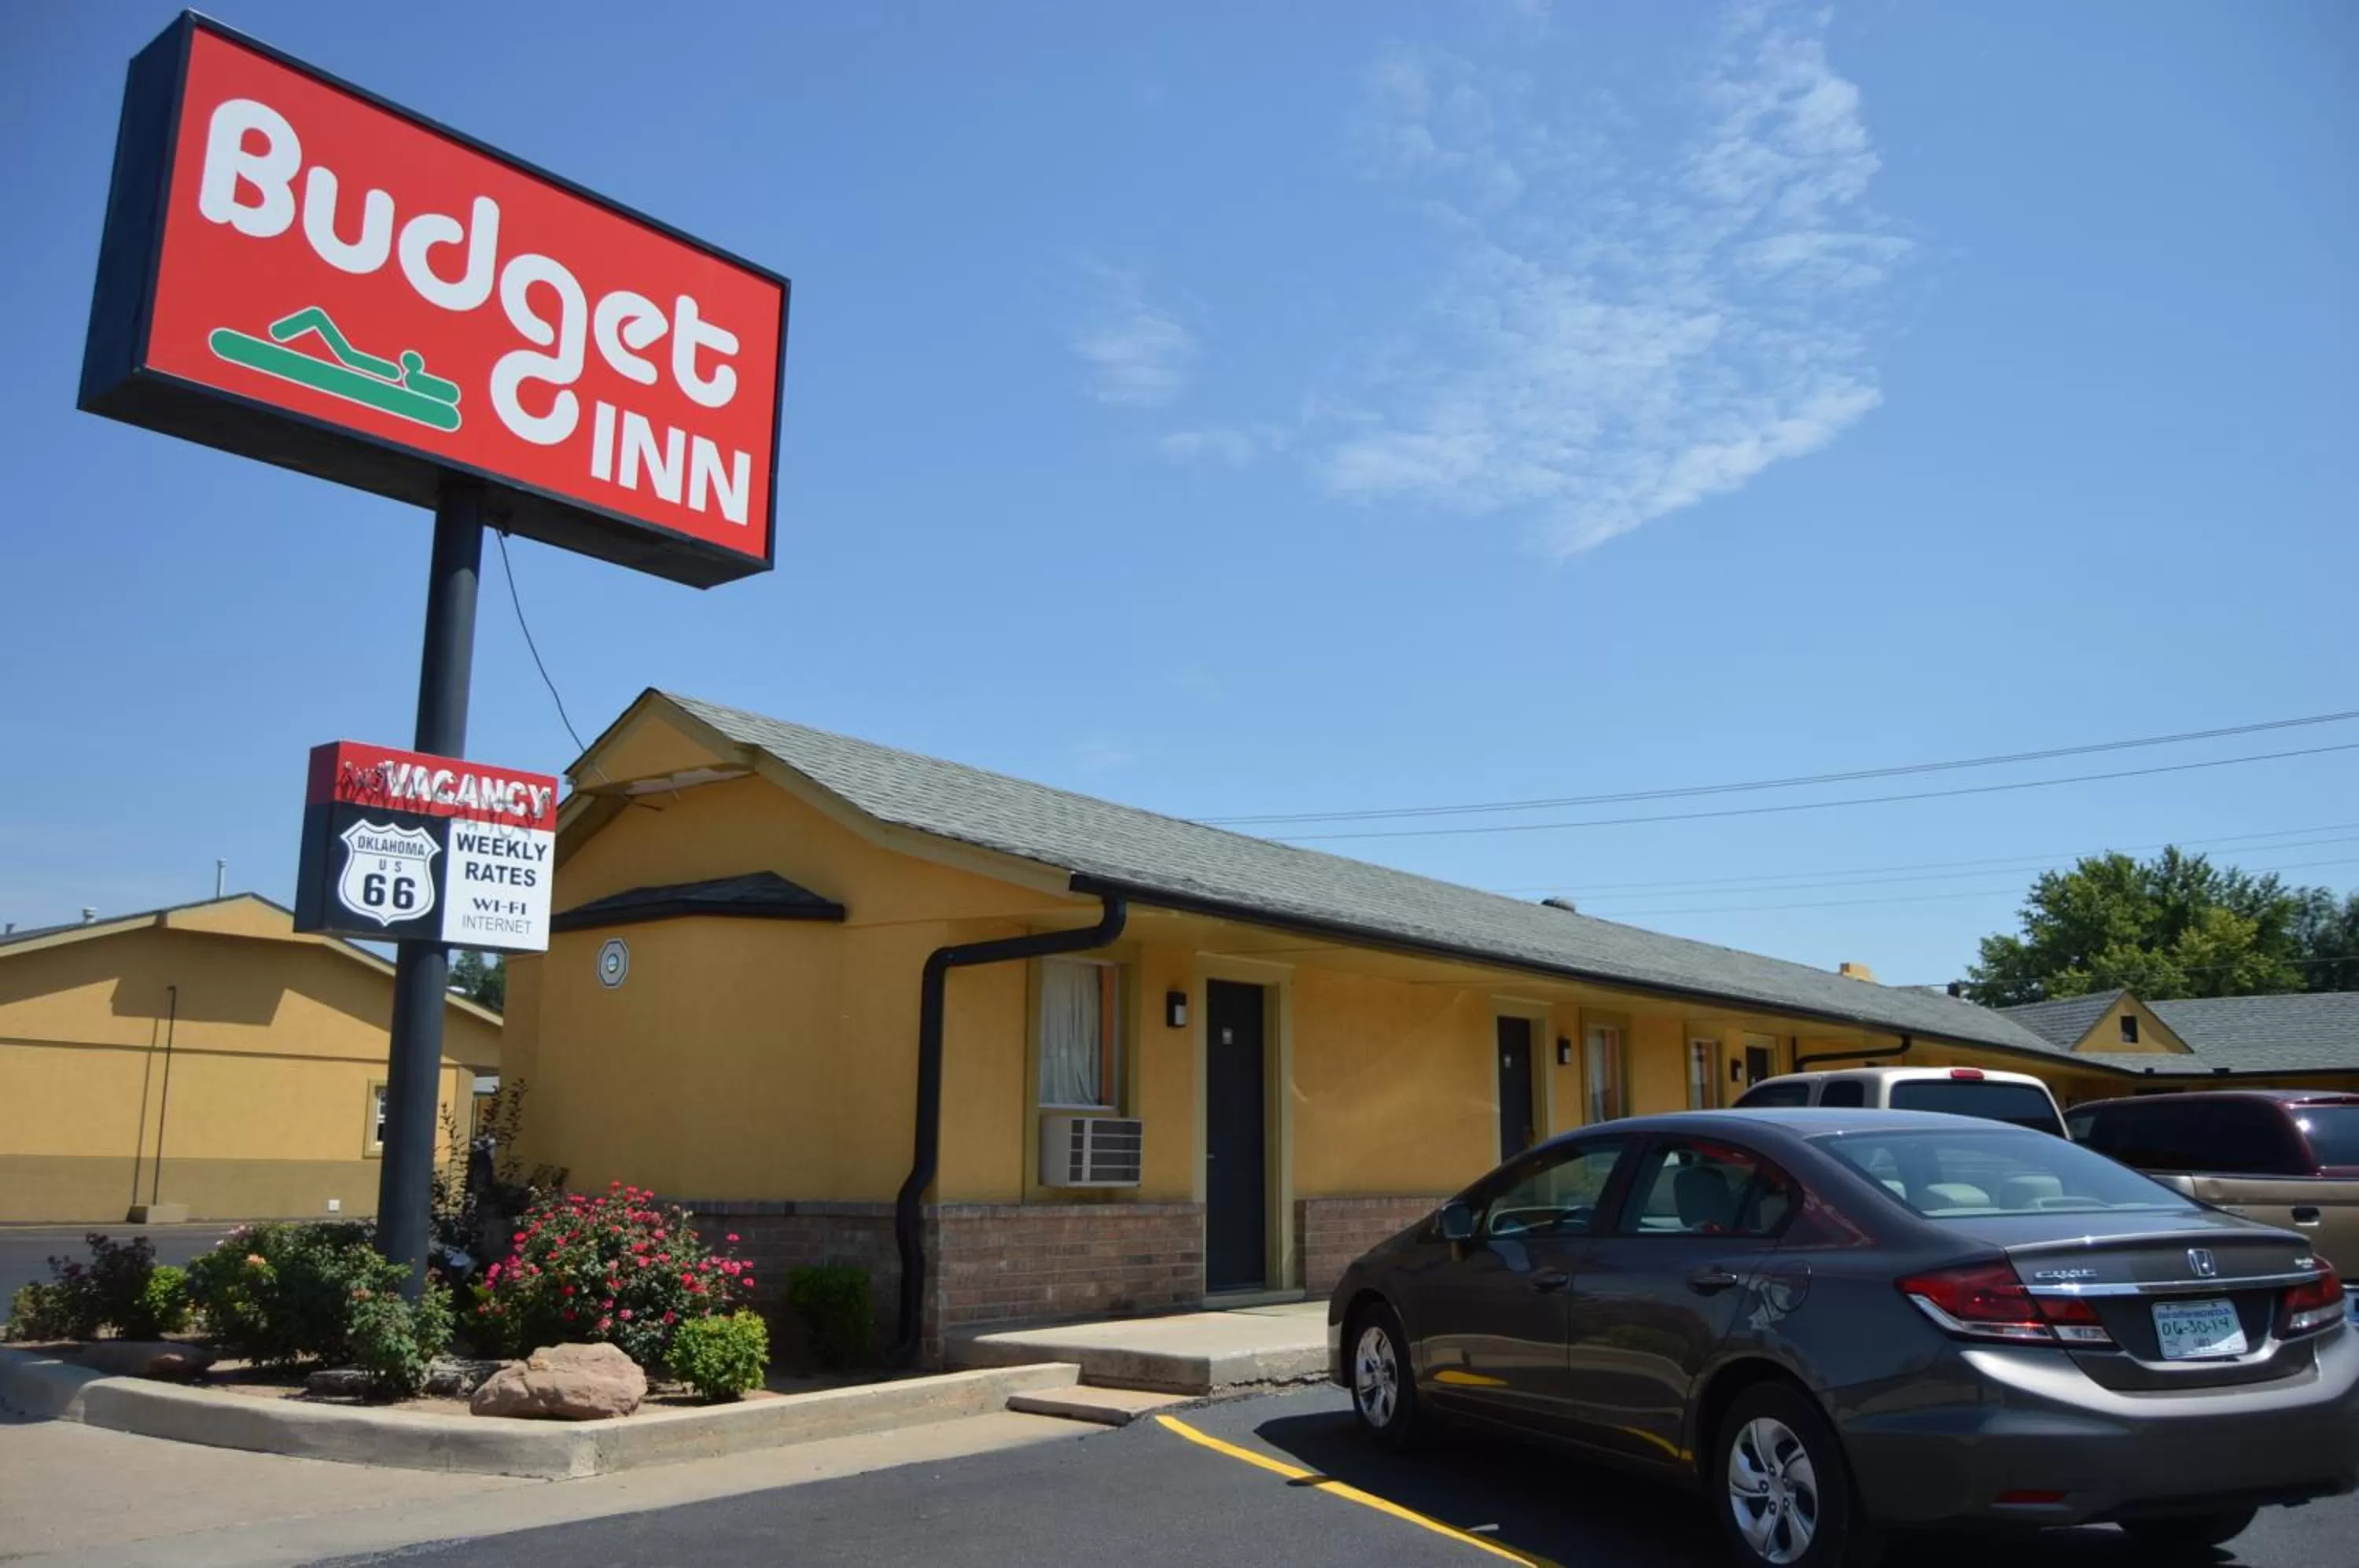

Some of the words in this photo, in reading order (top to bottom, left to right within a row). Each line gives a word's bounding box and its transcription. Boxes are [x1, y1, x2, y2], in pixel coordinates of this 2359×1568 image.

[199, 99, 739, 446] Budget
[591, 400, 752, 526] INN
[385, 760, 551, 819] VACANCY
[357, 836, 425, 856] OKLAHOMA
[456, 832, 547, 861] WEEKLY
[465, 861, 536, 887] RATES
[363, 873, 416, 910] 66
[473, 897, 526, 915] WI-FI
[462, 915, 532, 934] INTERNET
